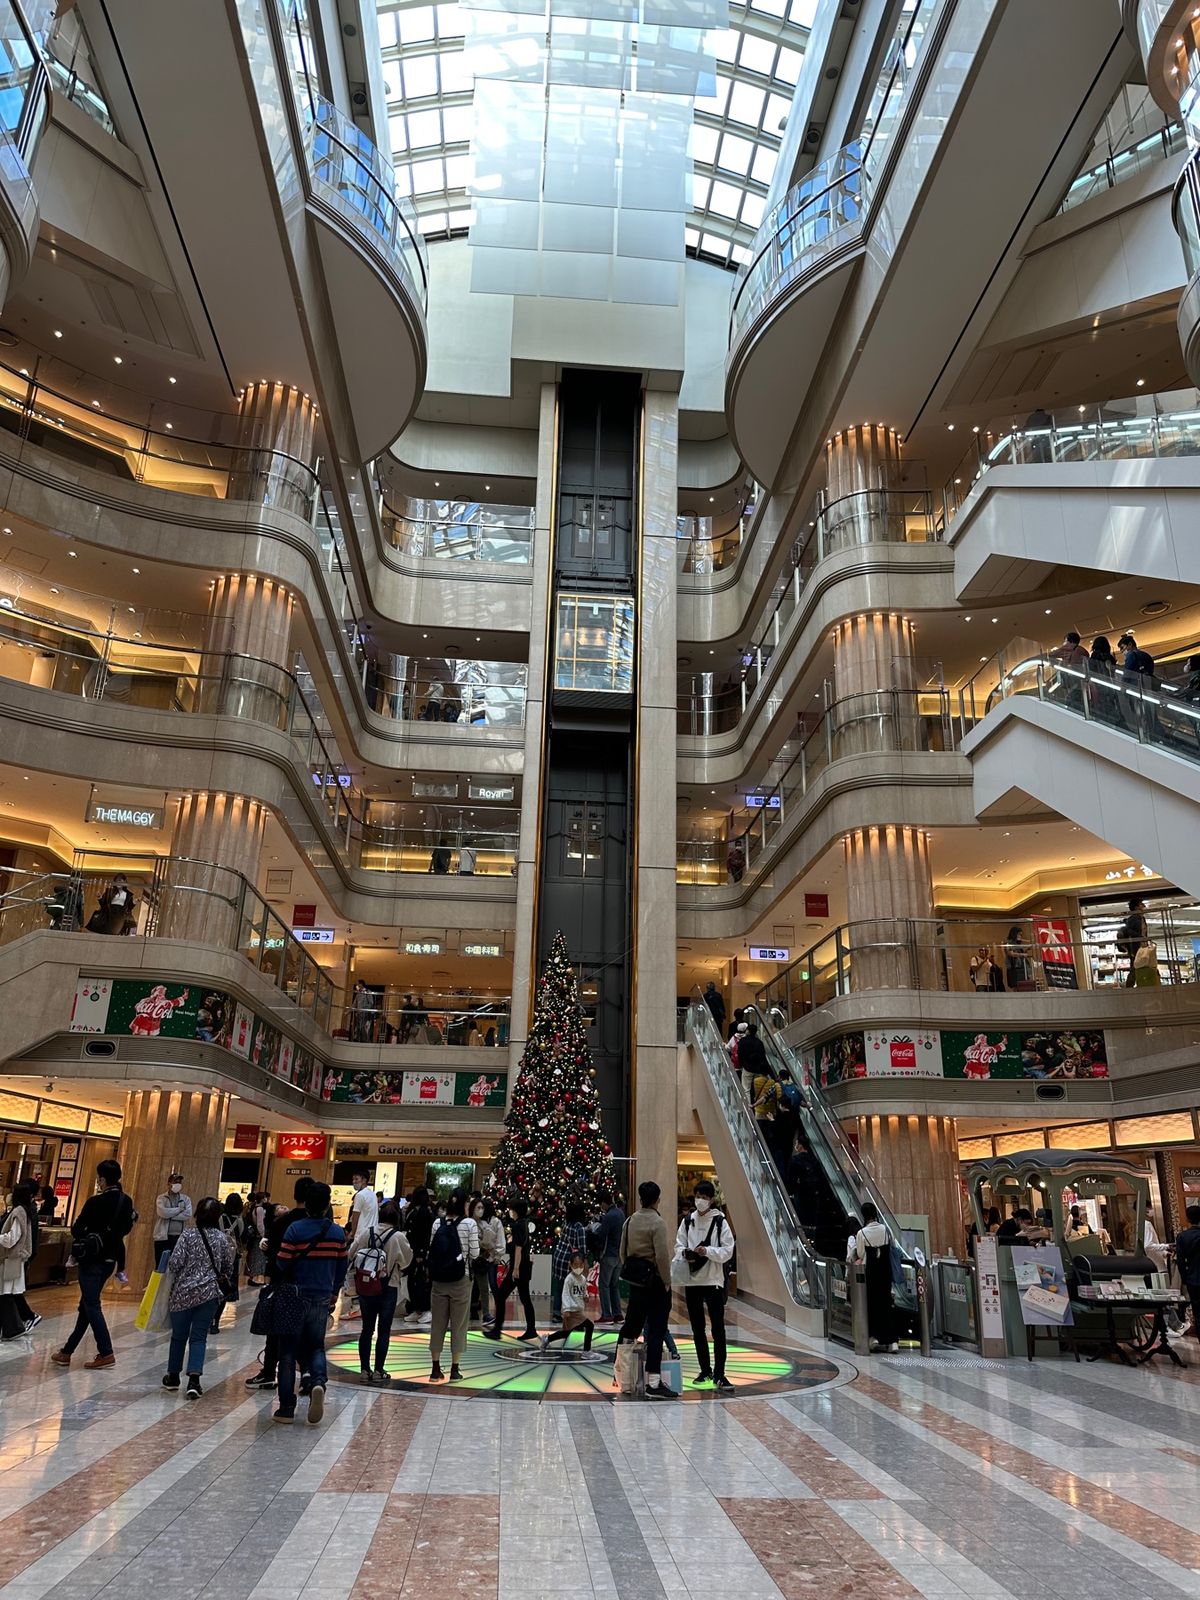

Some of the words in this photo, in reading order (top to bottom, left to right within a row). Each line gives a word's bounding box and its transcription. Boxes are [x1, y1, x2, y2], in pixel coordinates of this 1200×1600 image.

[282, 1136, 323, 1146] レストラン
[378, 1145, 416, 1155] Garden
[419, 1146, 479, 1156] Restaurant
